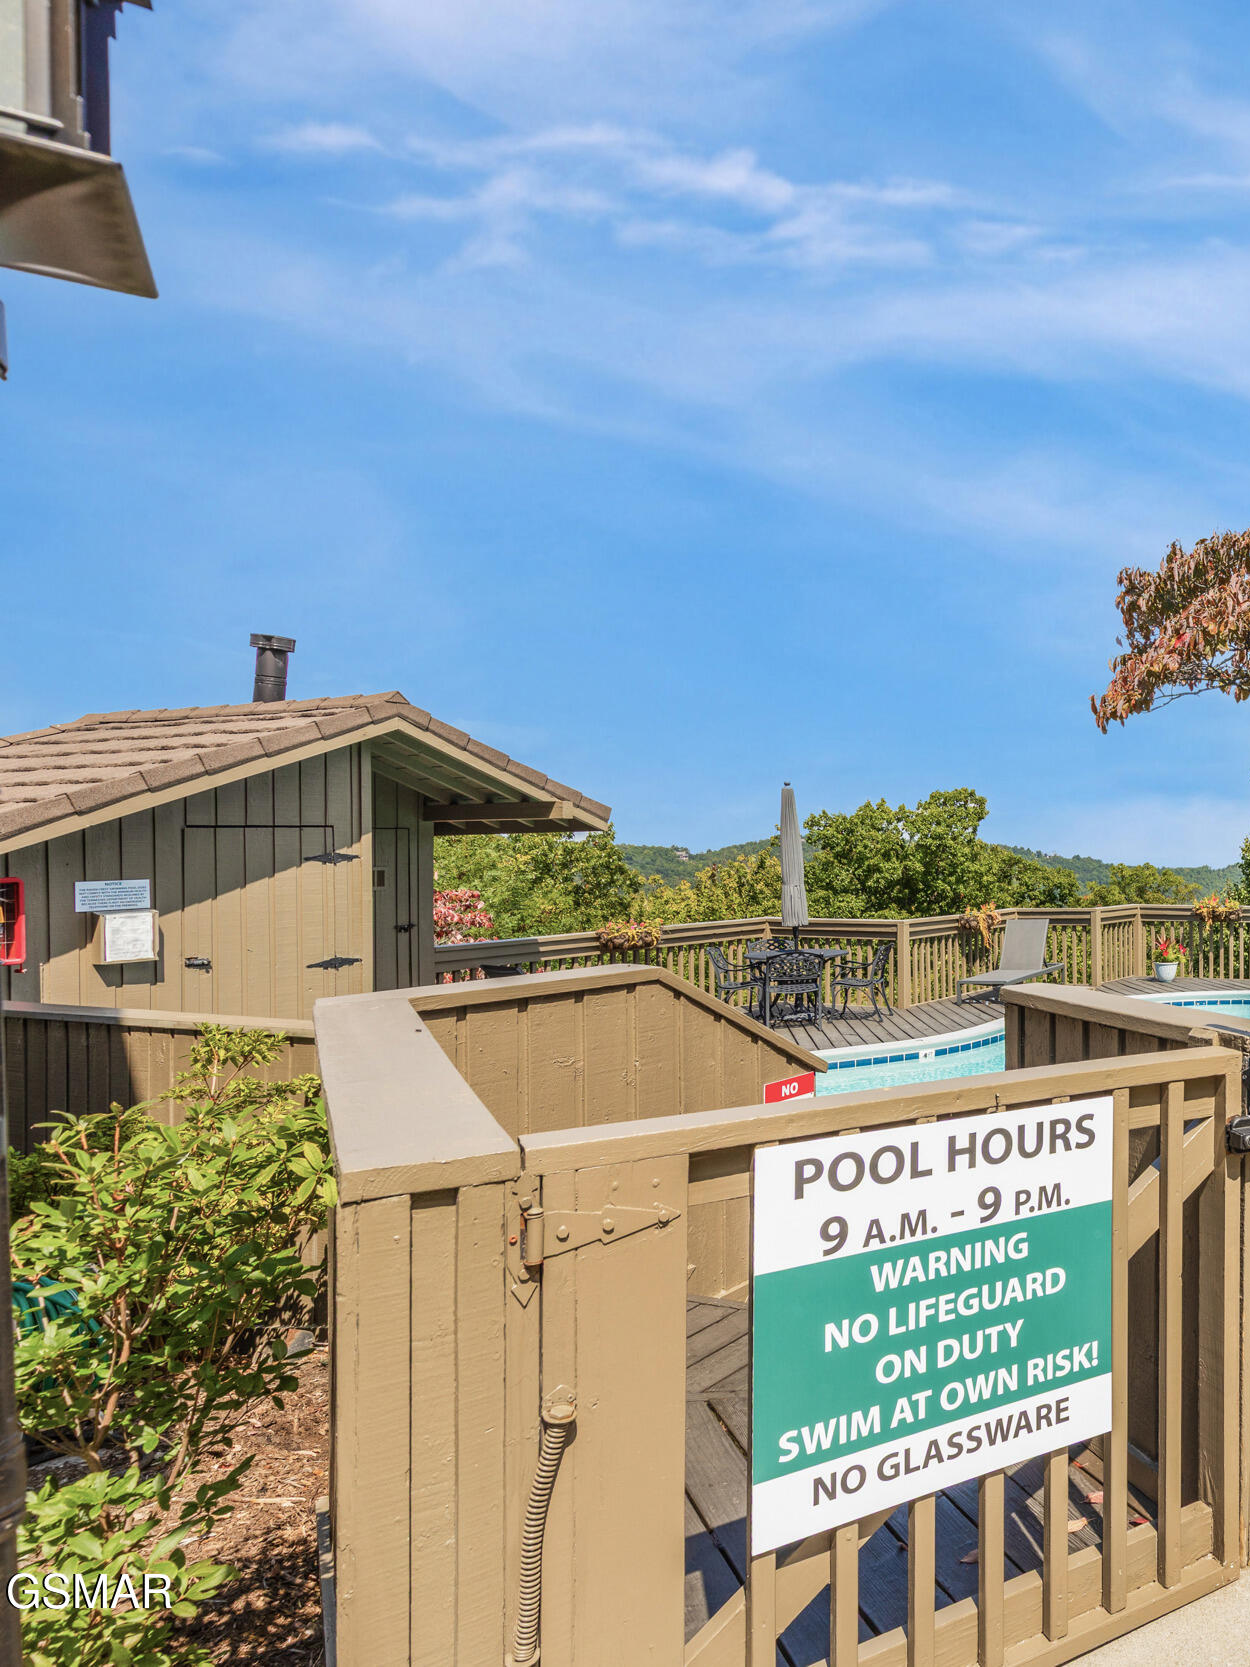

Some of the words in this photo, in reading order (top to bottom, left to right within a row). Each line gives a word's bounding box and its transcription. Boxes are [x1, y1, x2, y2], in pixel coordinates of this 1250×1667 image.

[781, 1082, 799, 1097] NO
[794, 1141, 933, 1200] POOL
[947, 1113, 1096, 1172] HOURS
[819, 1216, 849, 1257] 9
[863, 1209, 938, 1248] A.M.
[951, 1209, 965, 1218] -
[977, 1186, 1002, 1224] 9
[1014, 1182, 1071, 1216] P.M.
[870, 1232, 1029, 1293] WARNING
[824, 1313, 879, 1353] NO
[888, 1267, 1067, 1337] LIFEGUARD
[875, 1345, 927, 1384] ON
[937, 1318, 1025, 1368] DUTY
[778, 1404, 881, 1463] SWIM
[890, 1389, 933, 1428] AT
[940, 1364, 1019, 1412] OWN
[1027, 1340, 1099, 1386] RISK!
[813, 1463, 867, 1507] NO
[876, 1396, 1070, 1481] GLASSWARE
